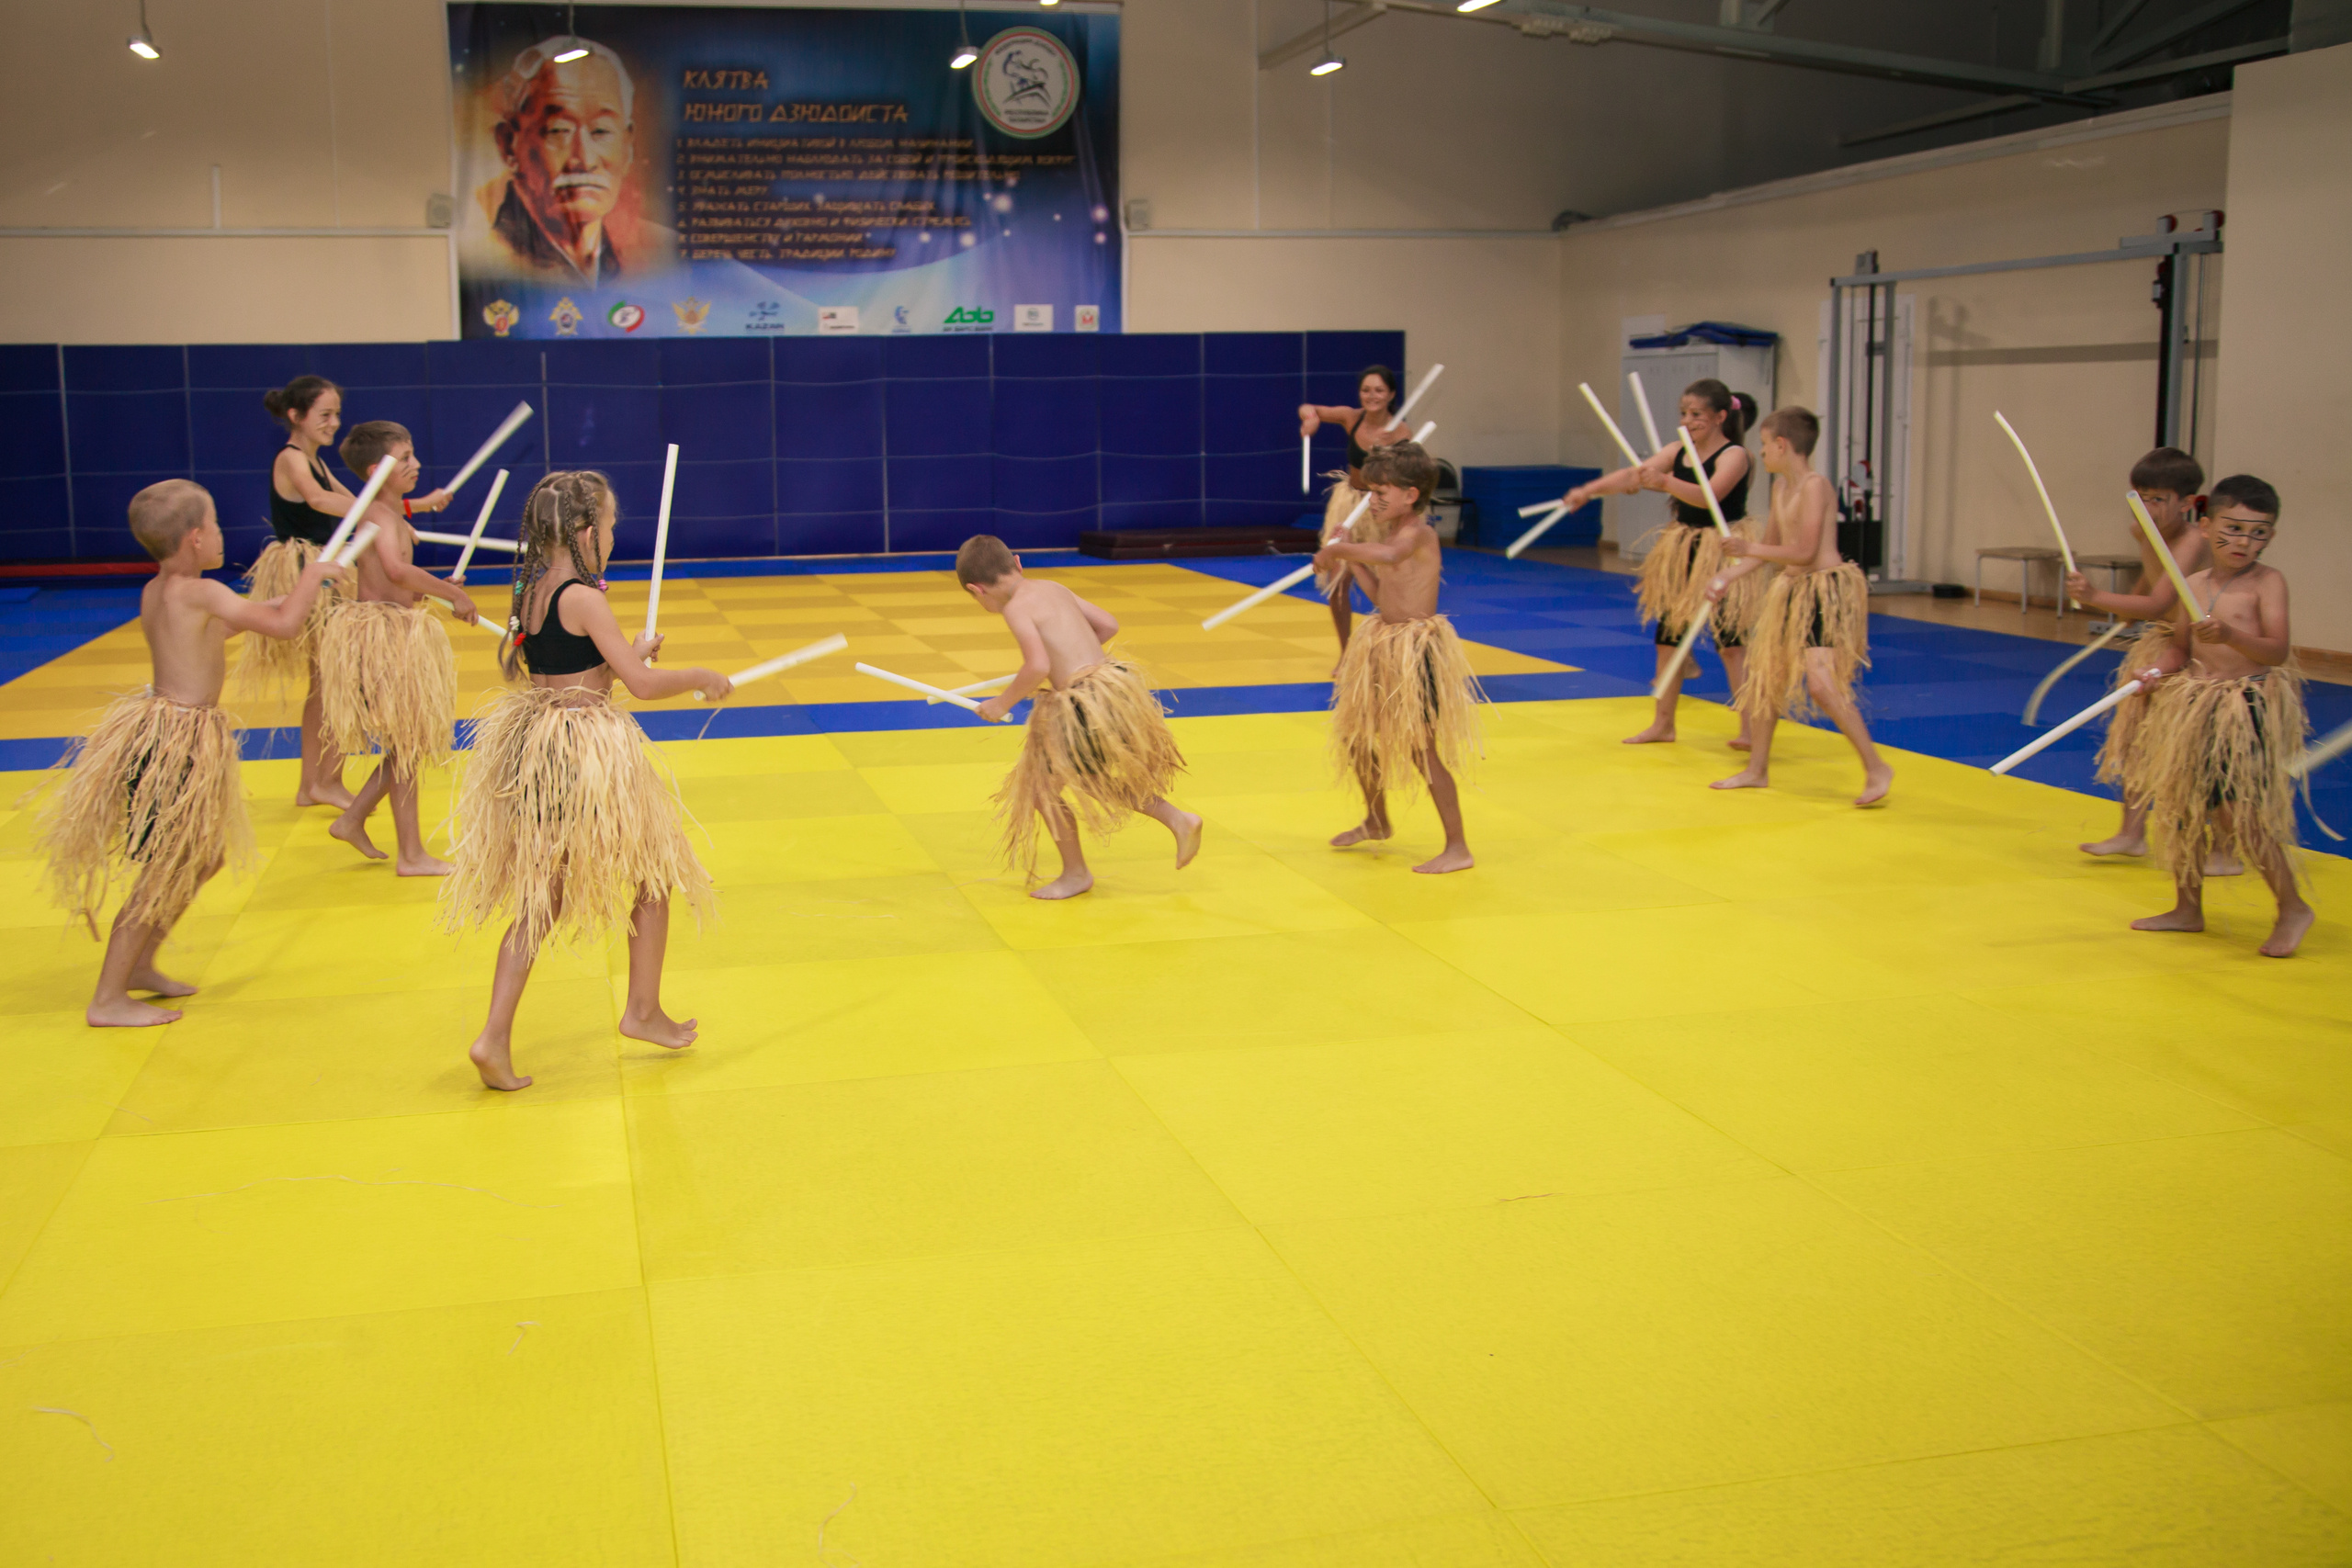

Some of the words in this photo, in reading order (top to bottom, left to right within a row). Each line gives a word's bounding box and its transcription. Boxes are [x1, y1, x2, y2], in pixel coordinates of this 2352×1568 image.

[684, 70, 769, 89] КЛЯТВА
[684, 103, 763, 123] ЮНОГО
[768, 103, 909, 123] ДЗЮДОИСТА
